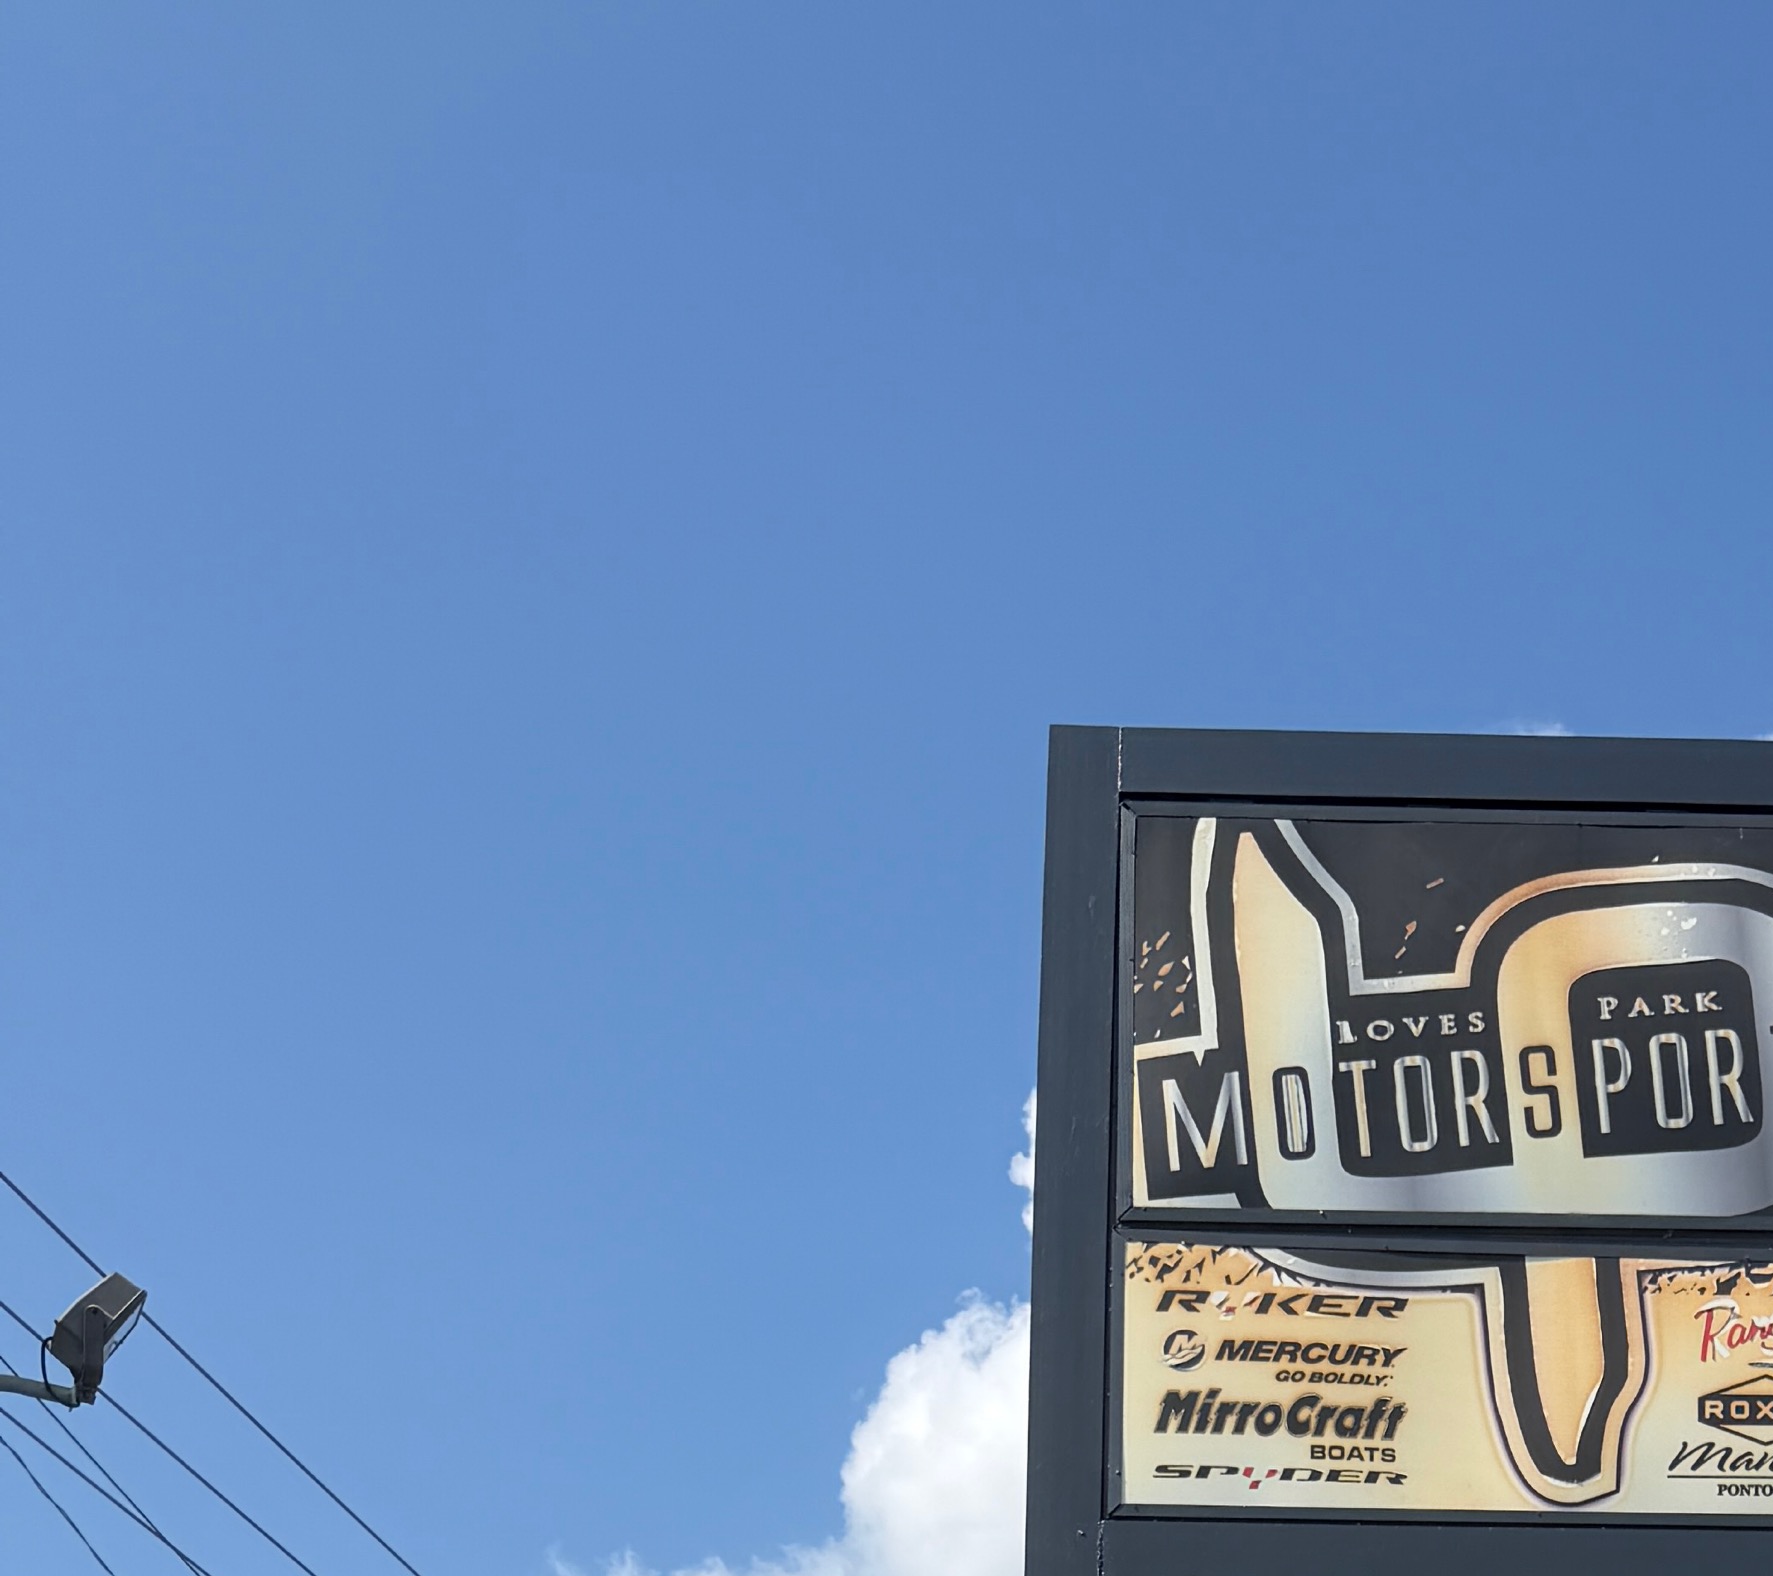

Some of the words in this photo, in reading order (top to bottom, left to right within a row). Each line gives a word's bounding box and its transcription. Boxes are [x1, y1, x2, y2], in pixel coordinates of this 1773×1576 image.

[1338, 1010, 1486, 1045] LOVES
[1598, 990, 1724, 1020] PARK
[1214, 1339, 1408, 1368] MERCURY
[1275, 1370, 1306, 1382] GO
[1153, 1389, 1405, 1441] MirroCraft
[1310, 1445, 1396, 1462] BOATS
[1153, 1464, 1409, 1490] SPYDER
